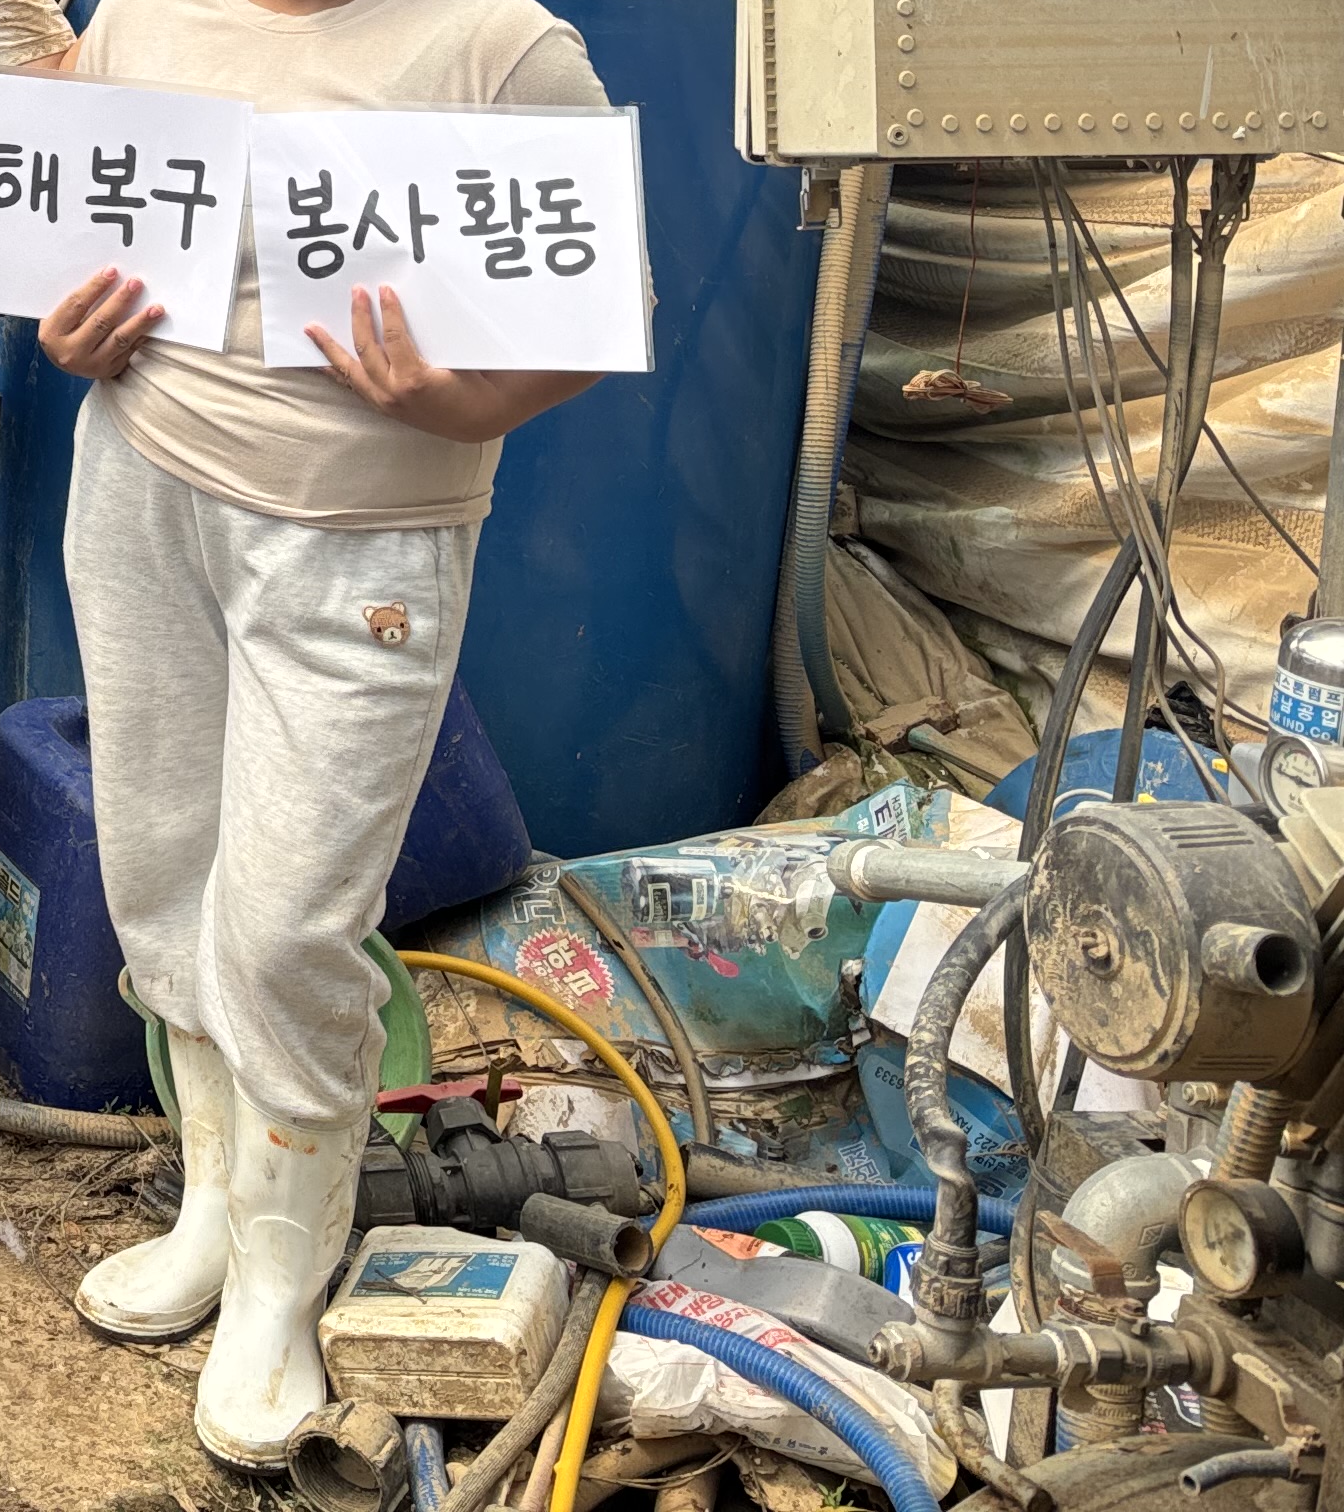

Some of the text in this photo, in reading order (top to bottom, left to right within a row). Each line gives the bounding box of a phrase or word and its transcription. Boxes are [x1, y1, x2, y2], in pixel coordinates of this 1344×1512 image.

[84, 143, 218, 252] 복구
[286, 169, 598, 280] 봉사 활동
[540, 937, 603, 998] 파워
